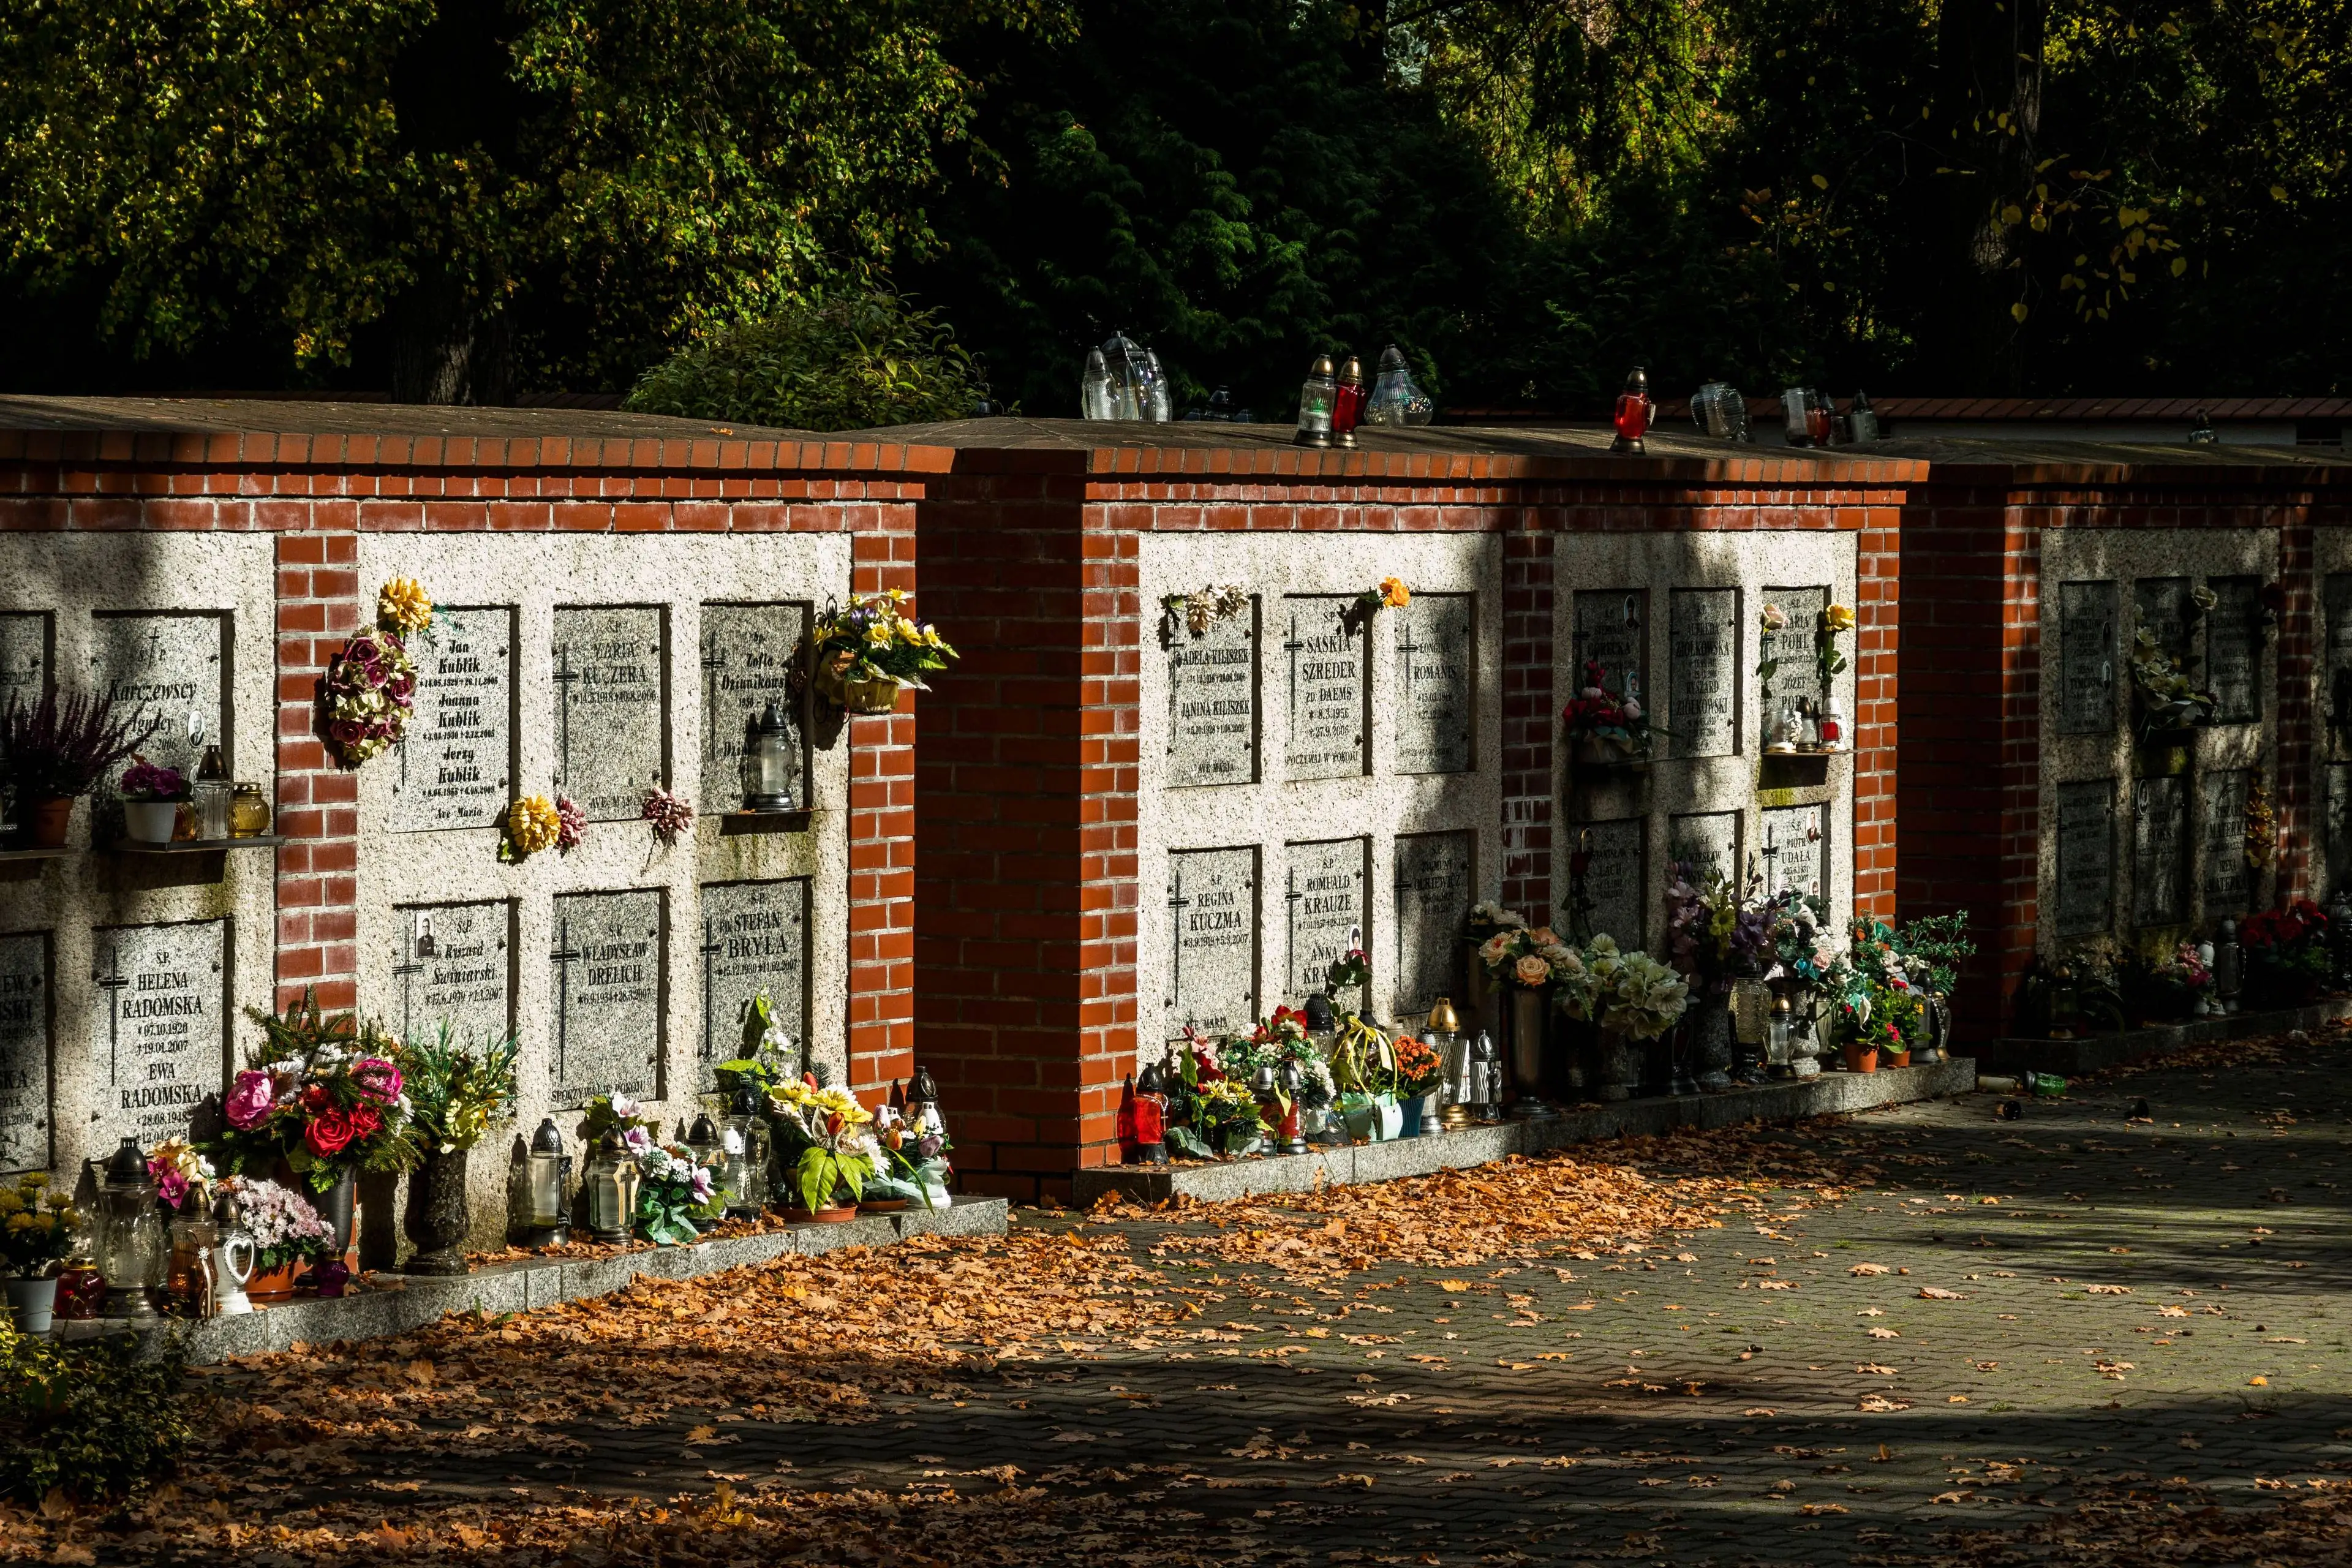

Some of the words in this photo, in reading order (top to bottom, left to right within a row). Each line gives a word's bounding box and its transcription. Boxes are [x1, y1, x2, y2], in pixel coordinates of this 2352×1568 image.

[449, 639, 469, 654] Jan
[1306, 635, 1352, 654] SASKIA
[1782, 634, 1809, 650] POHL
[1183, 650, 1210, 666] ADELA
[1212, 647, 1250, 665] KILISZEK
[439, 657, 480, 674] Kublik
[1303, 661, 1355, 681] SZREDER
[1413, 665, 1457, 680] ROMANIS
[582, 665, 647, 685] KUCZERA
[109, 679, 197, 704] Karczewscy
[1320, 686, 1352, 702] DAEMS
[1686, 680, 1720, 695] RYSZARD
[439, 693, 480, 707] Joanna
[1181, 702, 1212, 718] JANINA
[1213, 699, 1251, 717] KILISZEK
[1781, 695, 1805, 710] POH
[438, 710, 481, 728] Kublik
[442, 745, 475, 763] Jerzy
[1324, 752, 1330, 763] W
[1332, 750, 1358, 762] POKOJU
[438, 766, 480, 783] Kublik
[1197, 764, 1211, 774] AVE
[590, 796, 608, 809] AVE
[435, 809, 451, 819] Ave
[457, 807, 482, 818] Maria
[1787, 837, 1806, 848] PIOTR
[1781, 850, 1811, 864] UDAŁA
[1306, 875, 1351, 892] ROMUALD
[1197, 891, 1235, 908] REGINA
[1305, 894, 1352, 914] KRAUZE
[734, 910, 782, 933] STEFAN
[1189, 911, 1242, 931] KUCZMA
[445, 941, 484, 964] Ryszard
[582, 941, 649, 965] WŁADYSŁAW
[728, 934, 788, 959] BRYŁA
[1311, 946, 1338, 962] ANNA
[138, 972, 188, 991] HELENA
[432, 962, 497, 986] Świniarski
[588, 964, 643, 986] DRELICH
[1303, 967, 1335, 984] KRAU
[123, 995, 203, 1019] RADOMSKA
[144, 1040, 189, 1055] 19.01.2007
[149, 1063, 175, 1080] EWA
[121, 1084, 202, 1109] RADOMSKA
